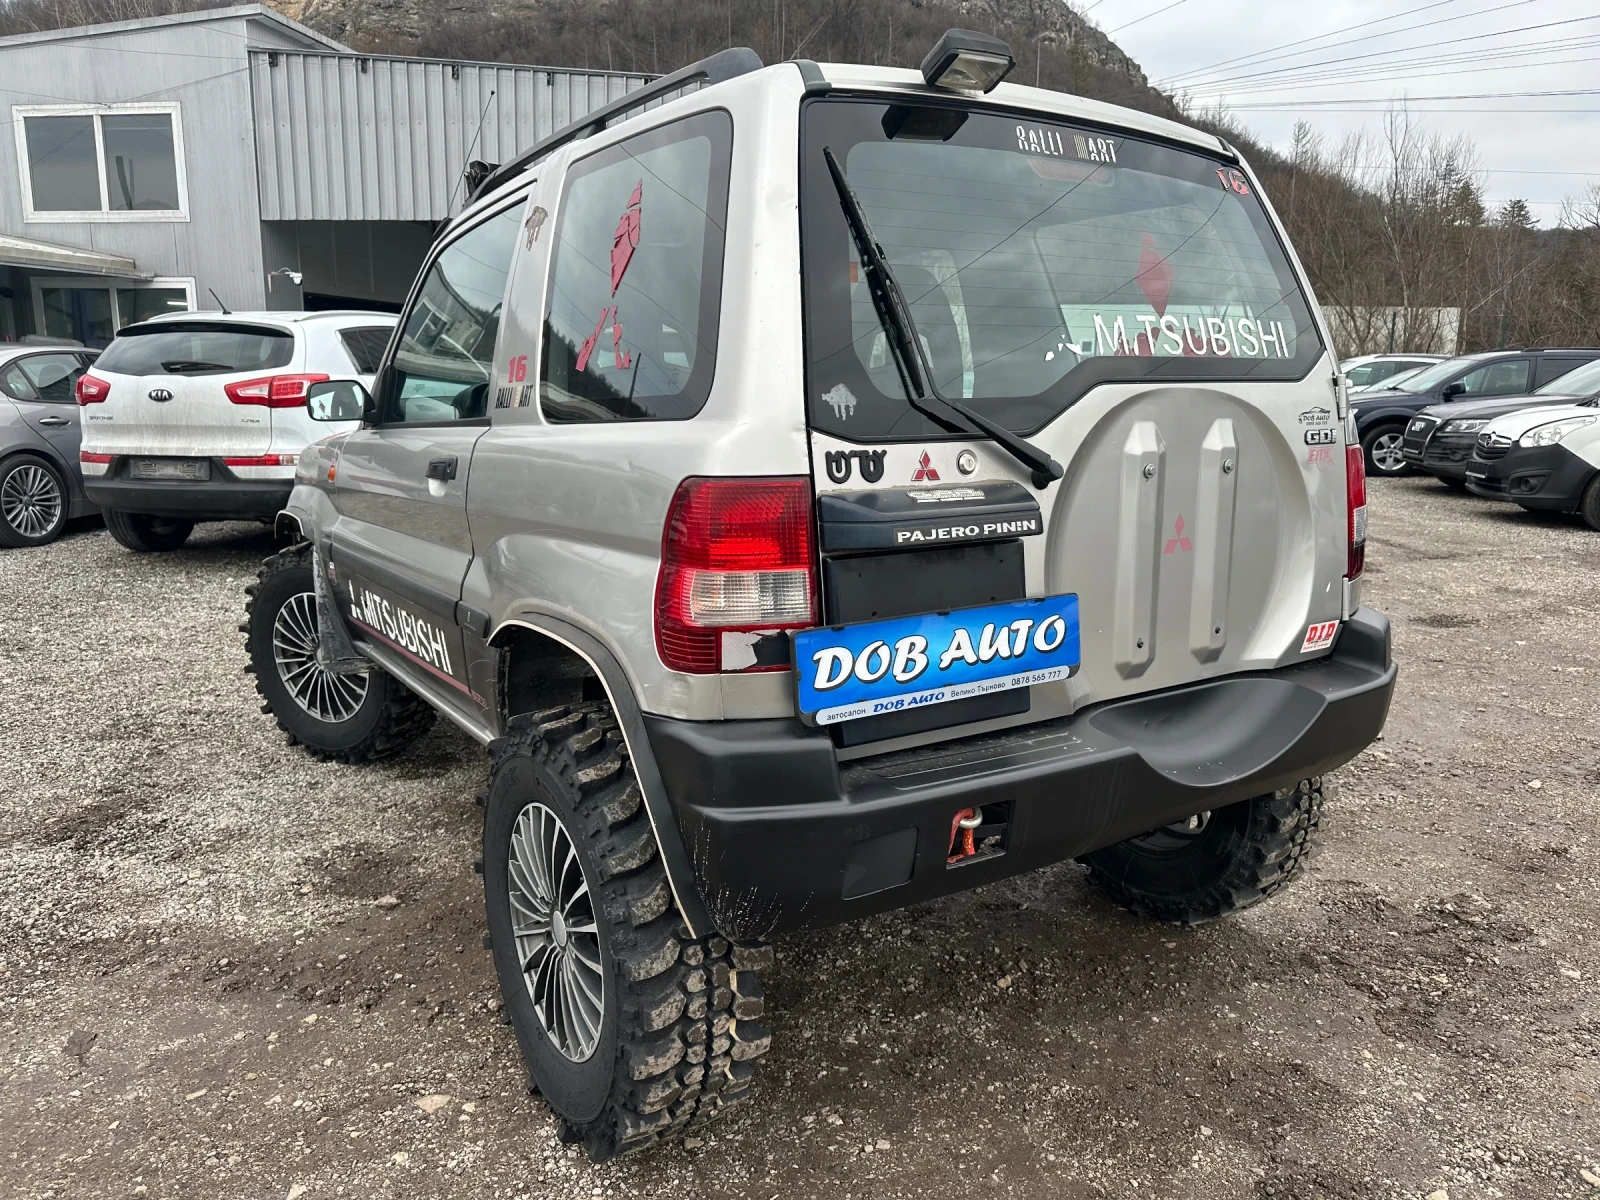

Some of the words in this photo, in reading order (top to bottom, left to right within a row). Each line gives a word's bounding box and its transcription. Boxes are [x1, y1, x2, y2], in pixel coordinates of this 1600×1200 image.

[1215, 168, 1249, 195] 16
[508, 354, 527, 383] 16
[151, 391, 170, 399] KIA
[1304, 428, 1337, 445] GDI
[897, 525, 980, 543] PAJERO
[360, 588, 453, 676] MITSUBISHI
[1306, 622, 1336, 642] DID
[812, 634, 929, 690] DOB
[938, 614, 1067, 672] AUTO
[826, 708, 866, 721] автосалон
[872, 699, 905, 713] DOB
[907, 691, 945, 706] AUTO
[950, 687, 976, 698] Велико
[977, 682, 1006, 693] Търново
[1011, 675, 1030, 686] 0878
[1032, 674, 1046, 682] 565
[1047, 670, 1062, 679] 777
